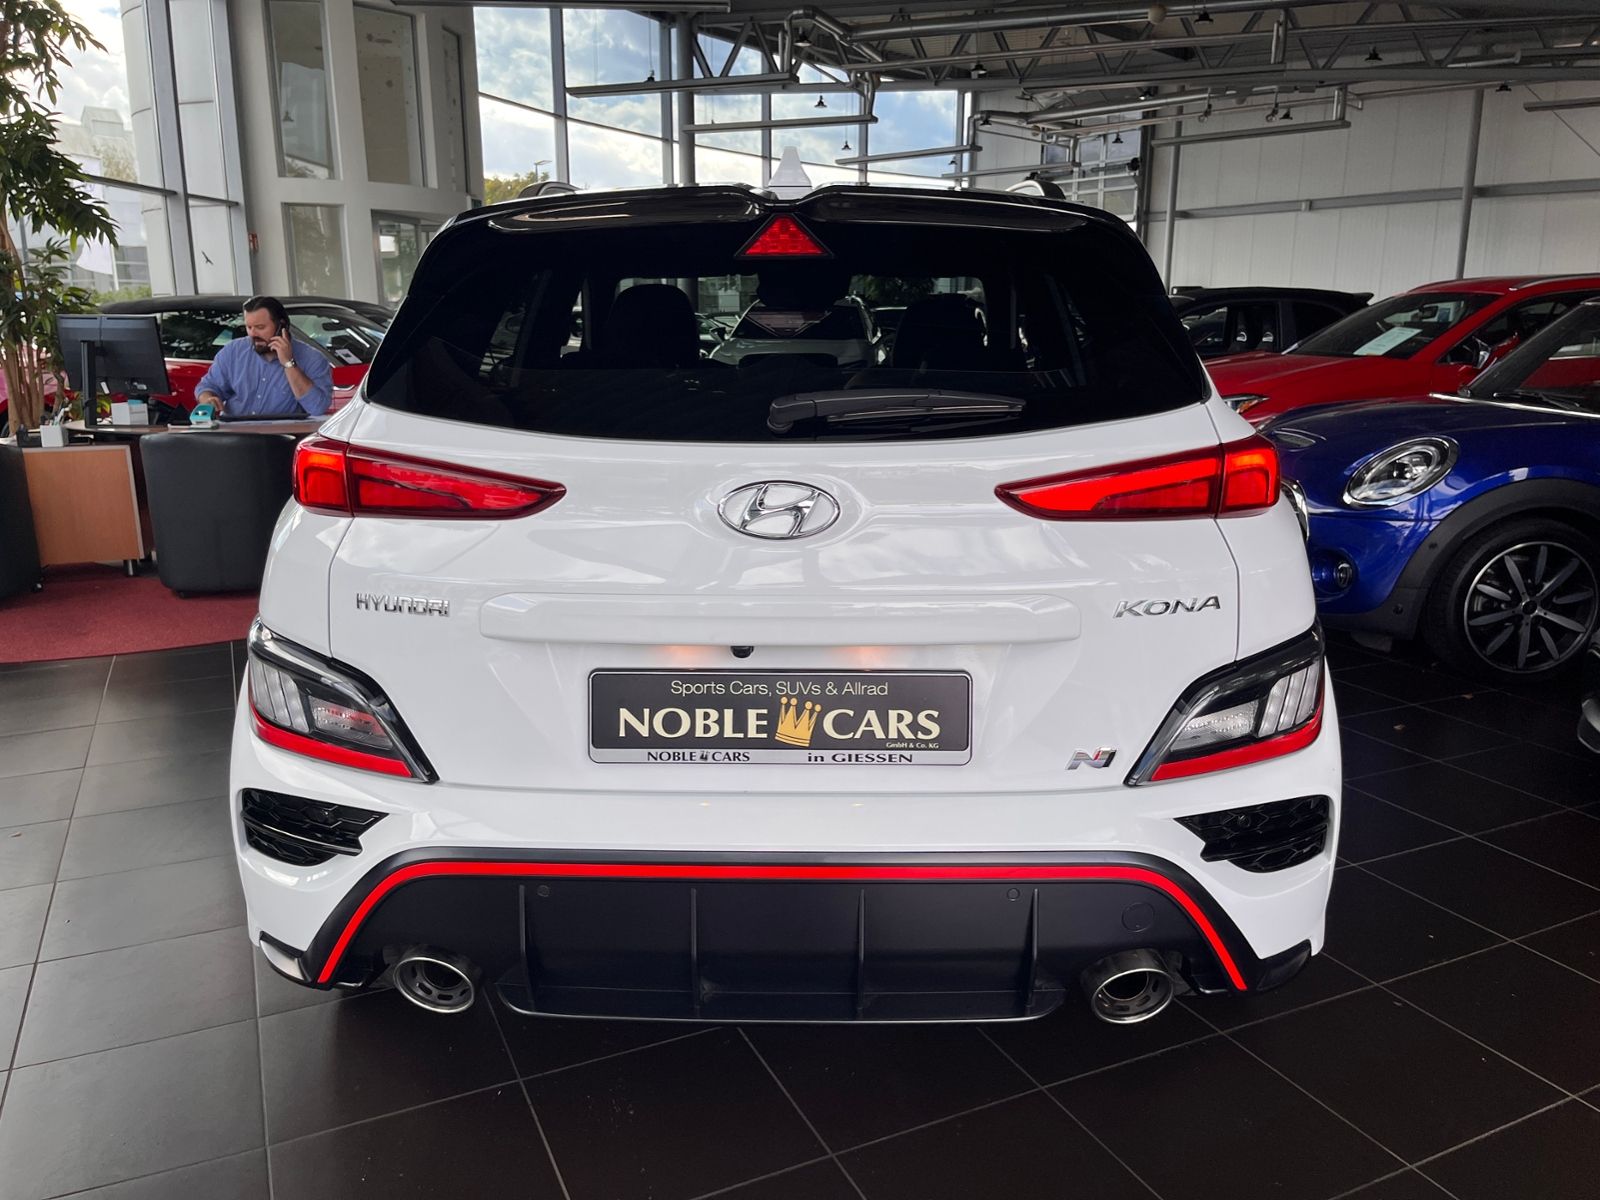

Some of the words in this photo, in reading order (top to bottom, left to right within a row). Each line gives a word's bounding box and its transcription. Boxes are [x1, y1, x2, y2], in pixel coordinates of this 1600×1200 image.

[356, 593, 450, 617] HYUNDAI
[1113, 596, 1221, 618] KONA
[671, 680, 726, 697] Sports
[729, 680, 772, 697] Cars,
[775, 681, 821, 696] SUVs
[825, 681, 838, 696] &
[842, 681, 889, 696] Allrad
[618, 707, 768, 738] NOBLE
[823, 708, 941, 740] CARS
[647, 751, 697, 762] NOBLE
[712, 751, 750, 762] CARS
[808, 752, 825, 763] in
[831, 753, 913, 763] GIESSEN
